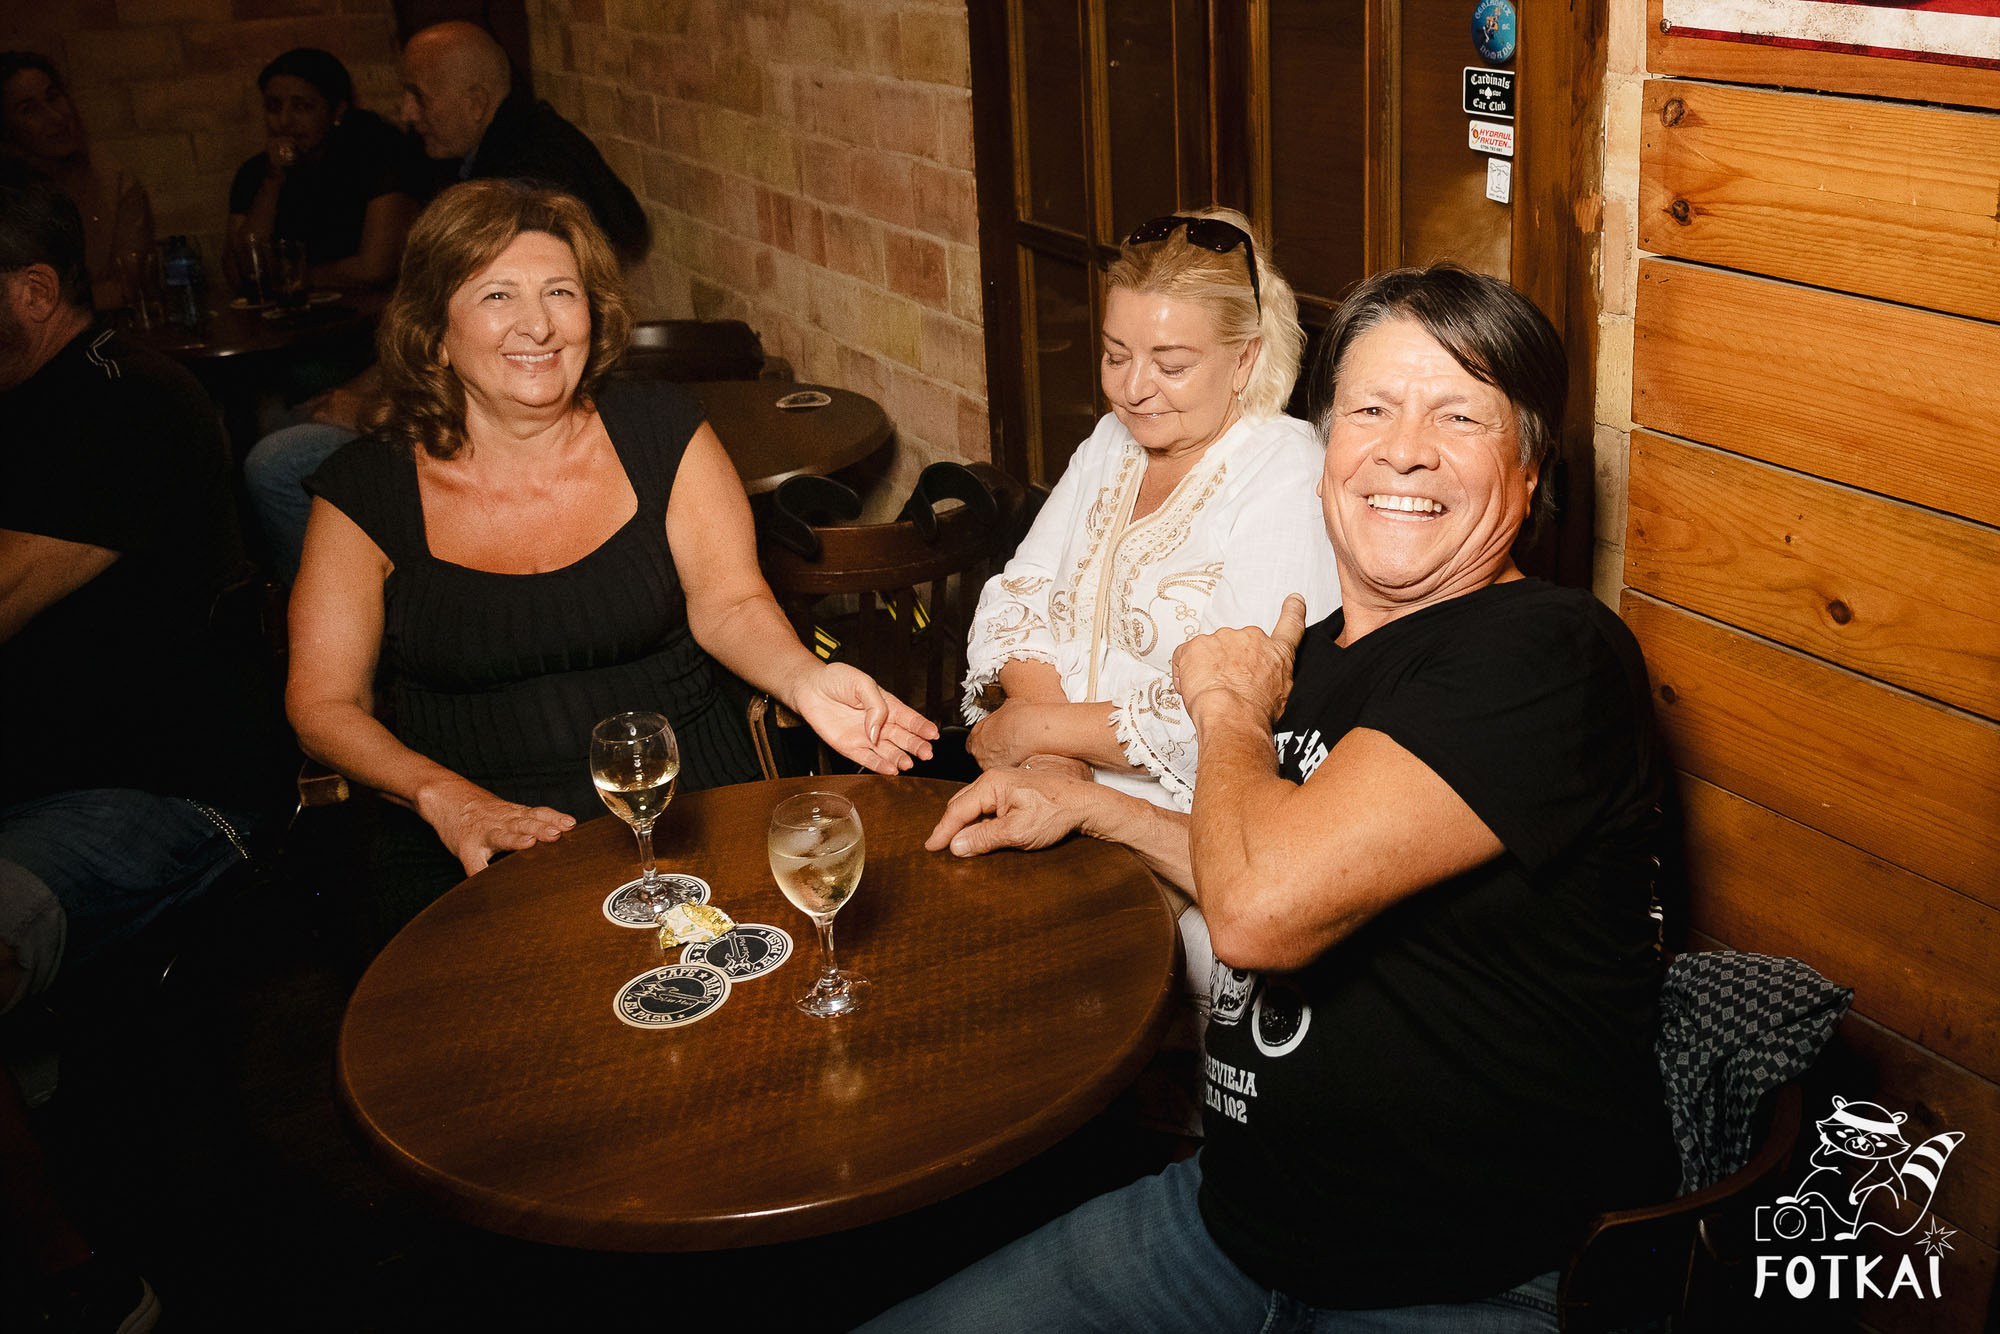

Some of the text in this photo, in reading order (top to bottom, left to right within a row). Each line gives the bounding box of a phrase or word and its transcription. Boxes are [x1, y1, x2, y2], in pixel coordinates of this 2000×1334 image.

[1471, 73, 1511, 90] Cardinals
[1472, 98, 1506, 112] Car Club
[1479, 129, 1512, 141] HYDRAUL
[656, 968, 721, 996] CAFE BAR
[623, 1001, 673, 1022] EL PASO
[1223, 1094, 1248, 1124] 102
